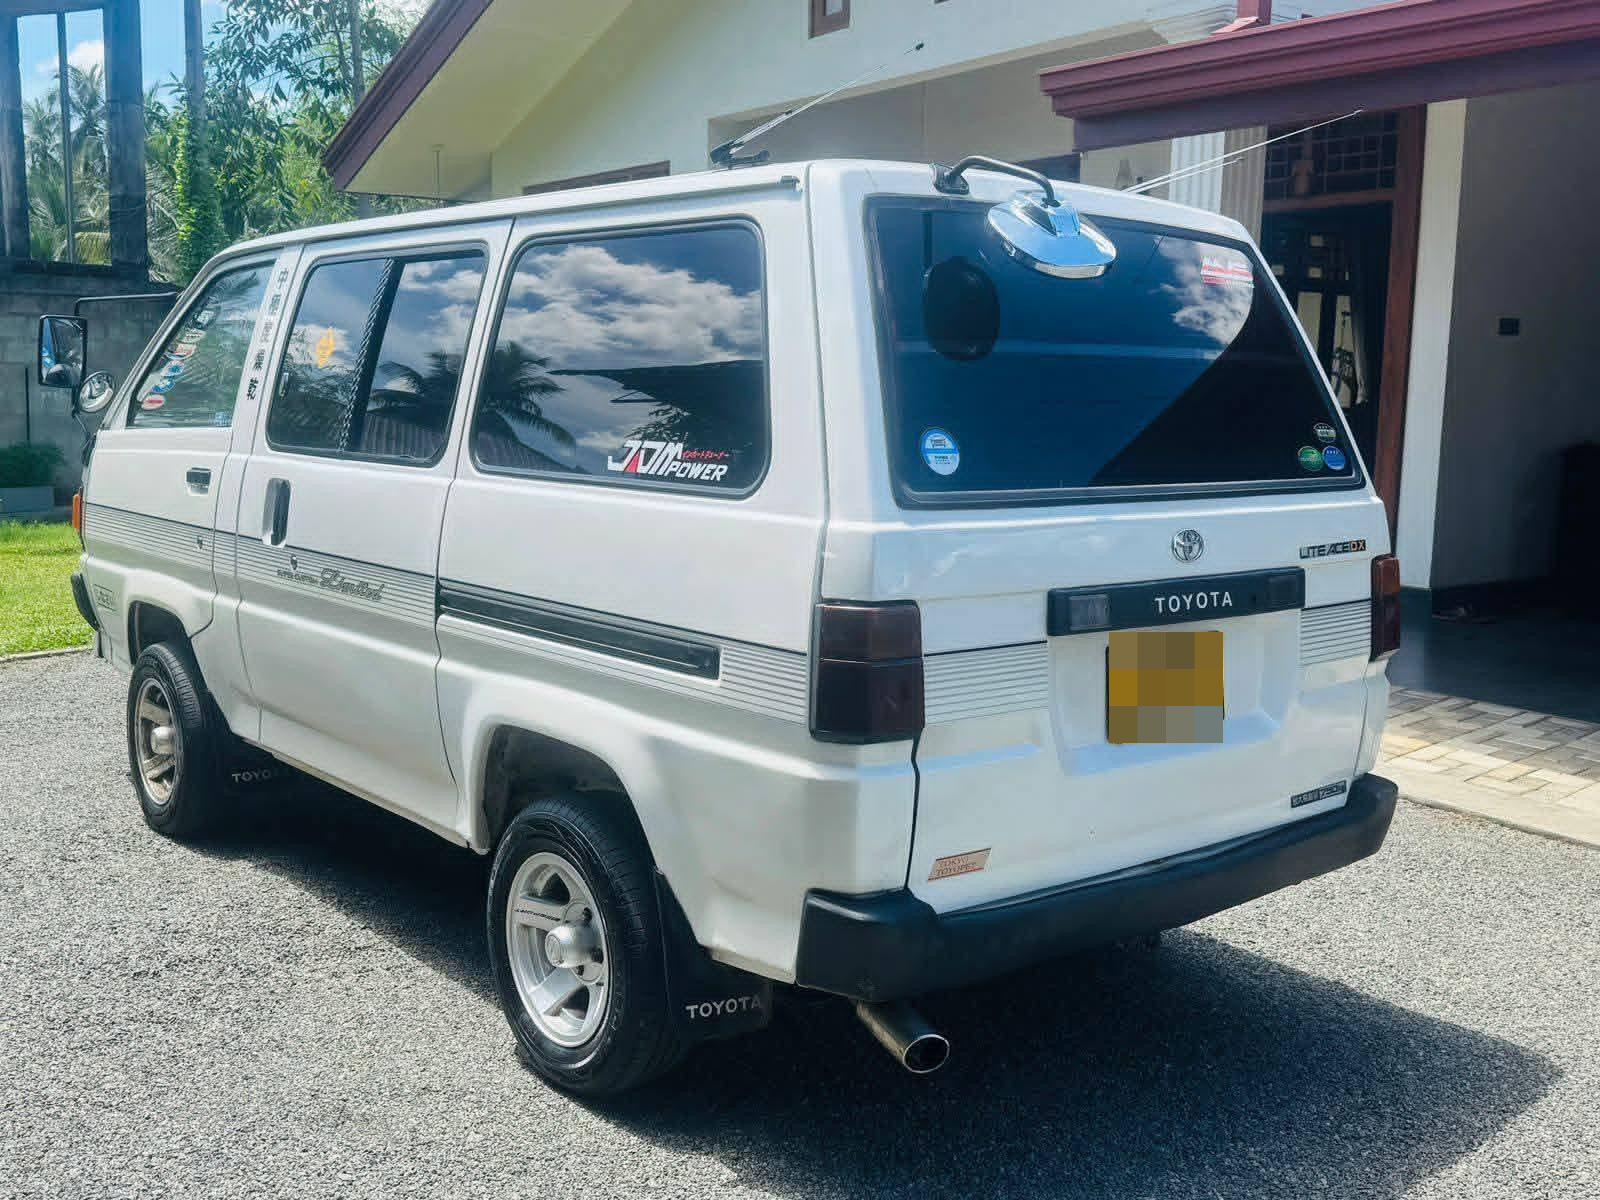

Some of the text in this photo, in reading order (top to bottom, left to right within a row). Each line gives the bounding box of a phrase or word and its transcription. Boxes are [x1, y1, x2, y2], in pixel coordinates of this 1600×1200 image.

[664, 460, 729, 481] POWER
[1154, 592, 1233, 613] TOYOTA
[685, 995, 762, 1019] TOYOTA
